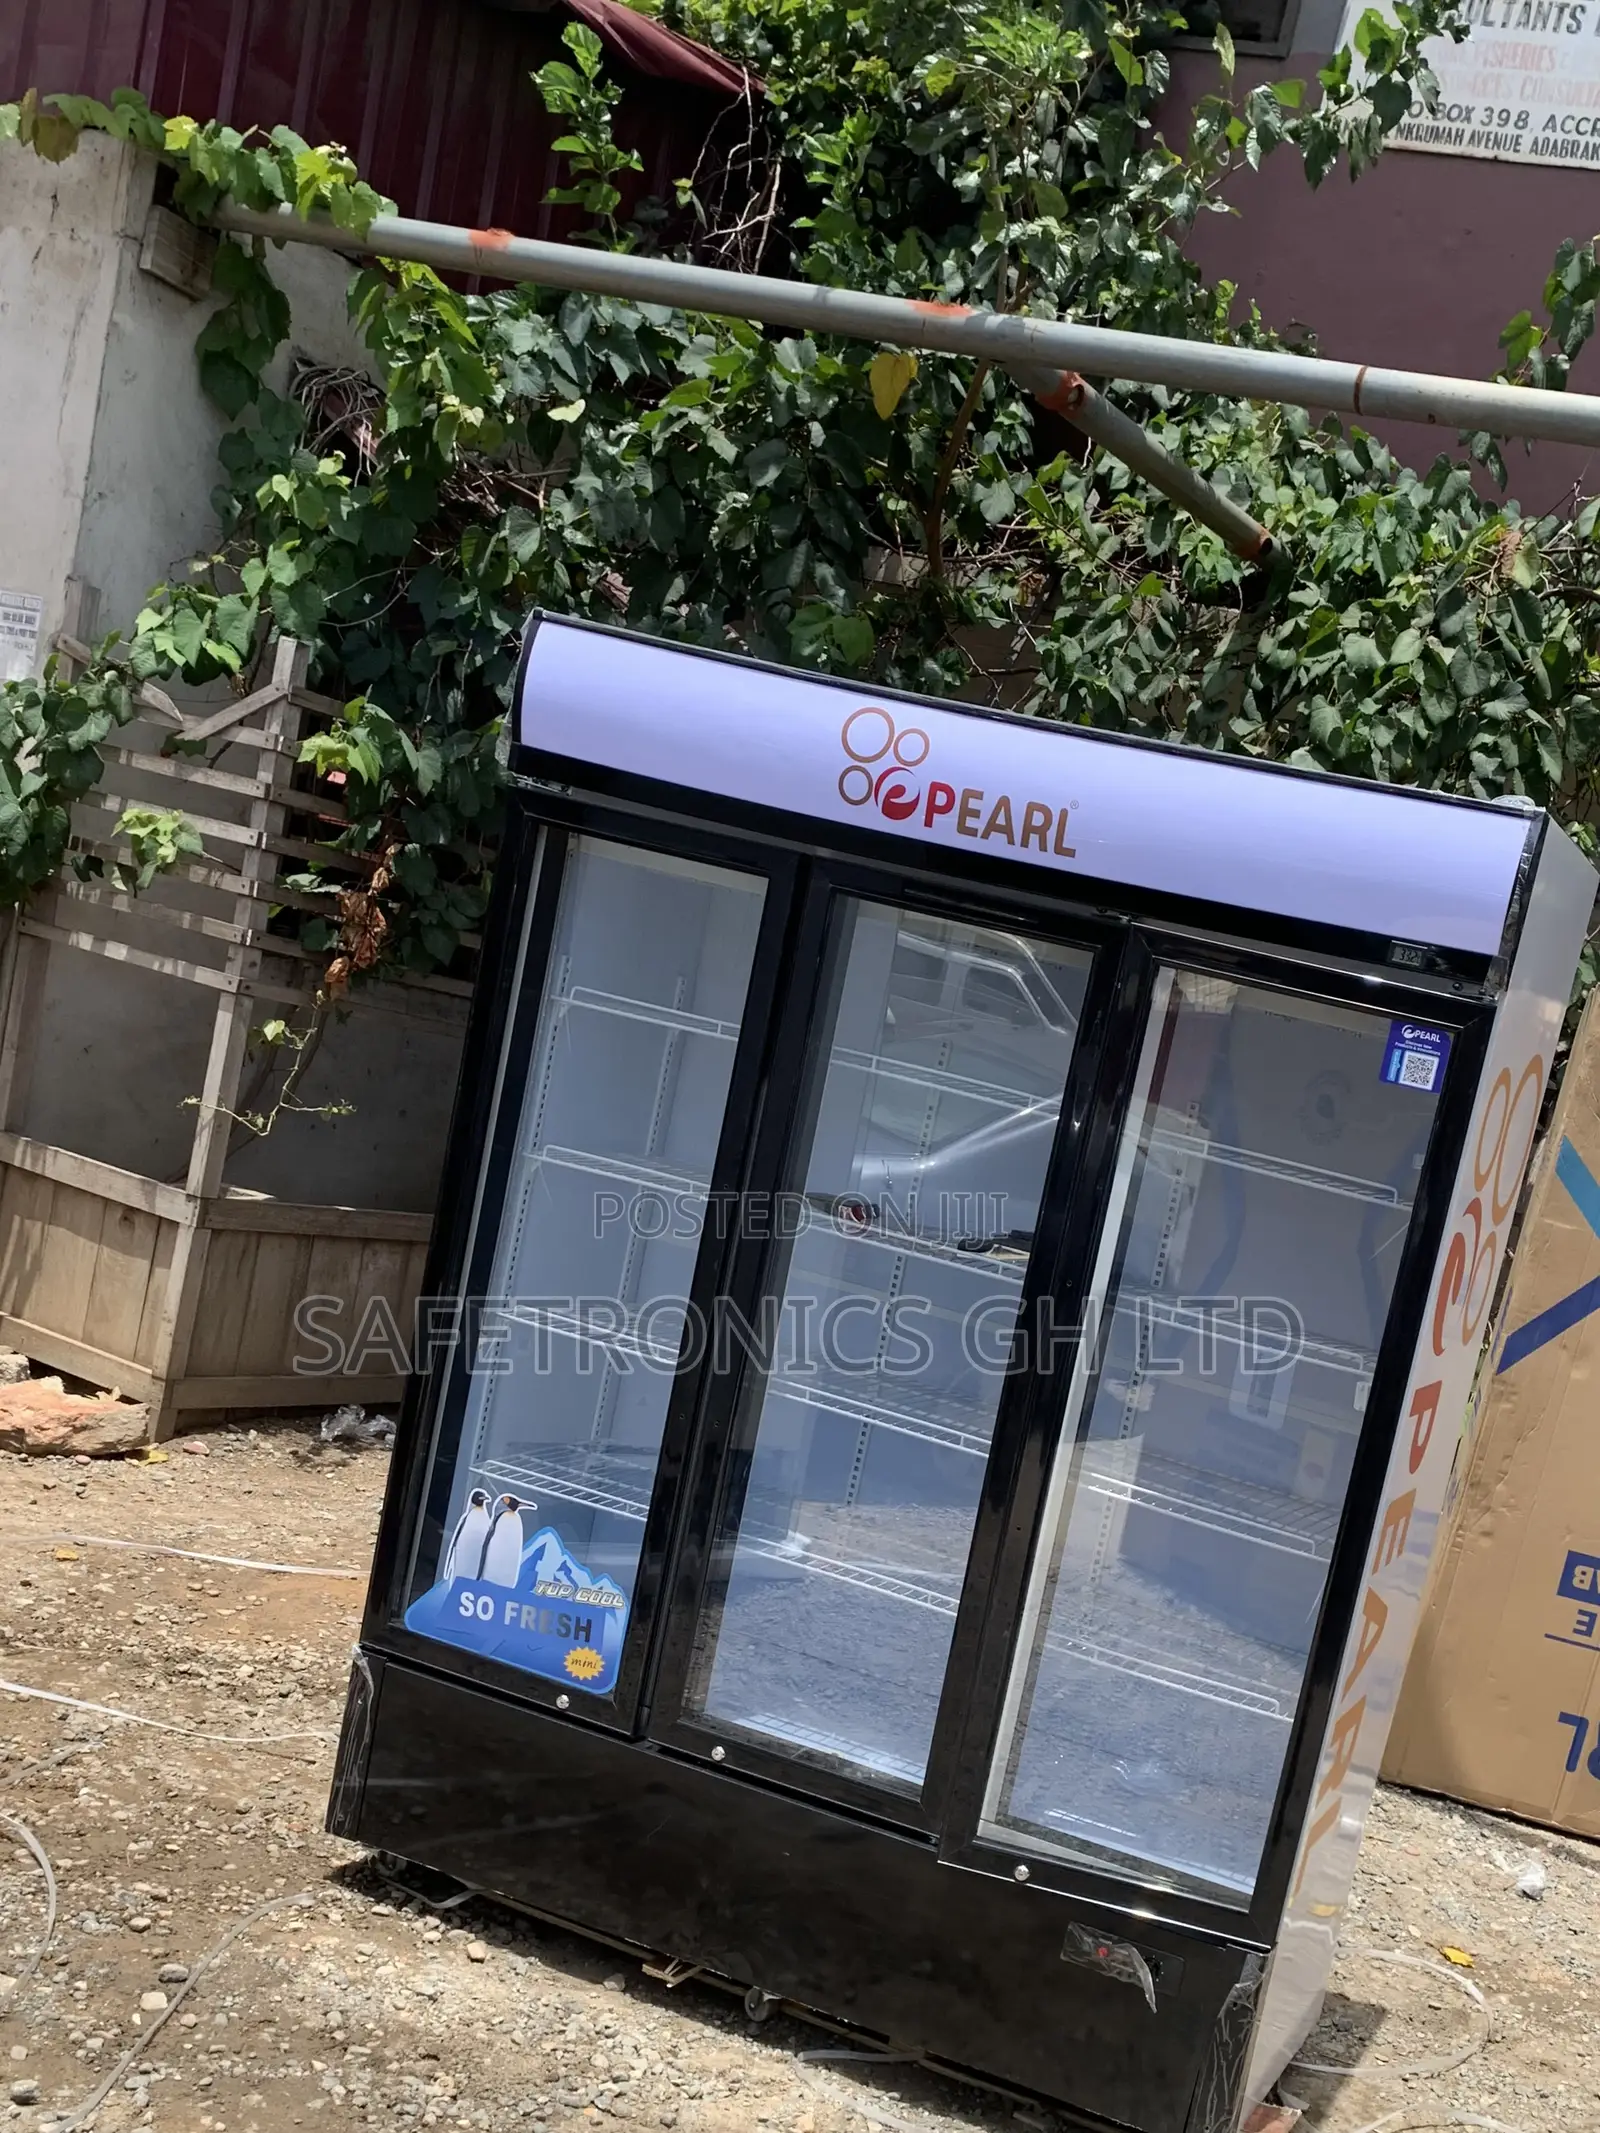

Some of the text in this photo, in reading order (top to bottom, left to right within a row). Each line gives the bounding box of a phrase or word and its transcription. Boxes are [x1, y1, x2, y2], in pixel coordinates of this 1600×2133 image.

[1460, 0, 1587, 36] ULTANTS
[1432, 102, 1476, 125] BOX
[1395, 122, 1465, 147] NKRUMAH
[1468, 129, 1523, 153] AVENUE
[924, 781, 1076, 858] PEARL
[1414, 1029, 1441, 1043] PEARL
[536, 1580, 626, 1609] TOP COOL
[459, 1591, 592, 1643] SO FRESH
[570, 1656, 599, 1671] mini
